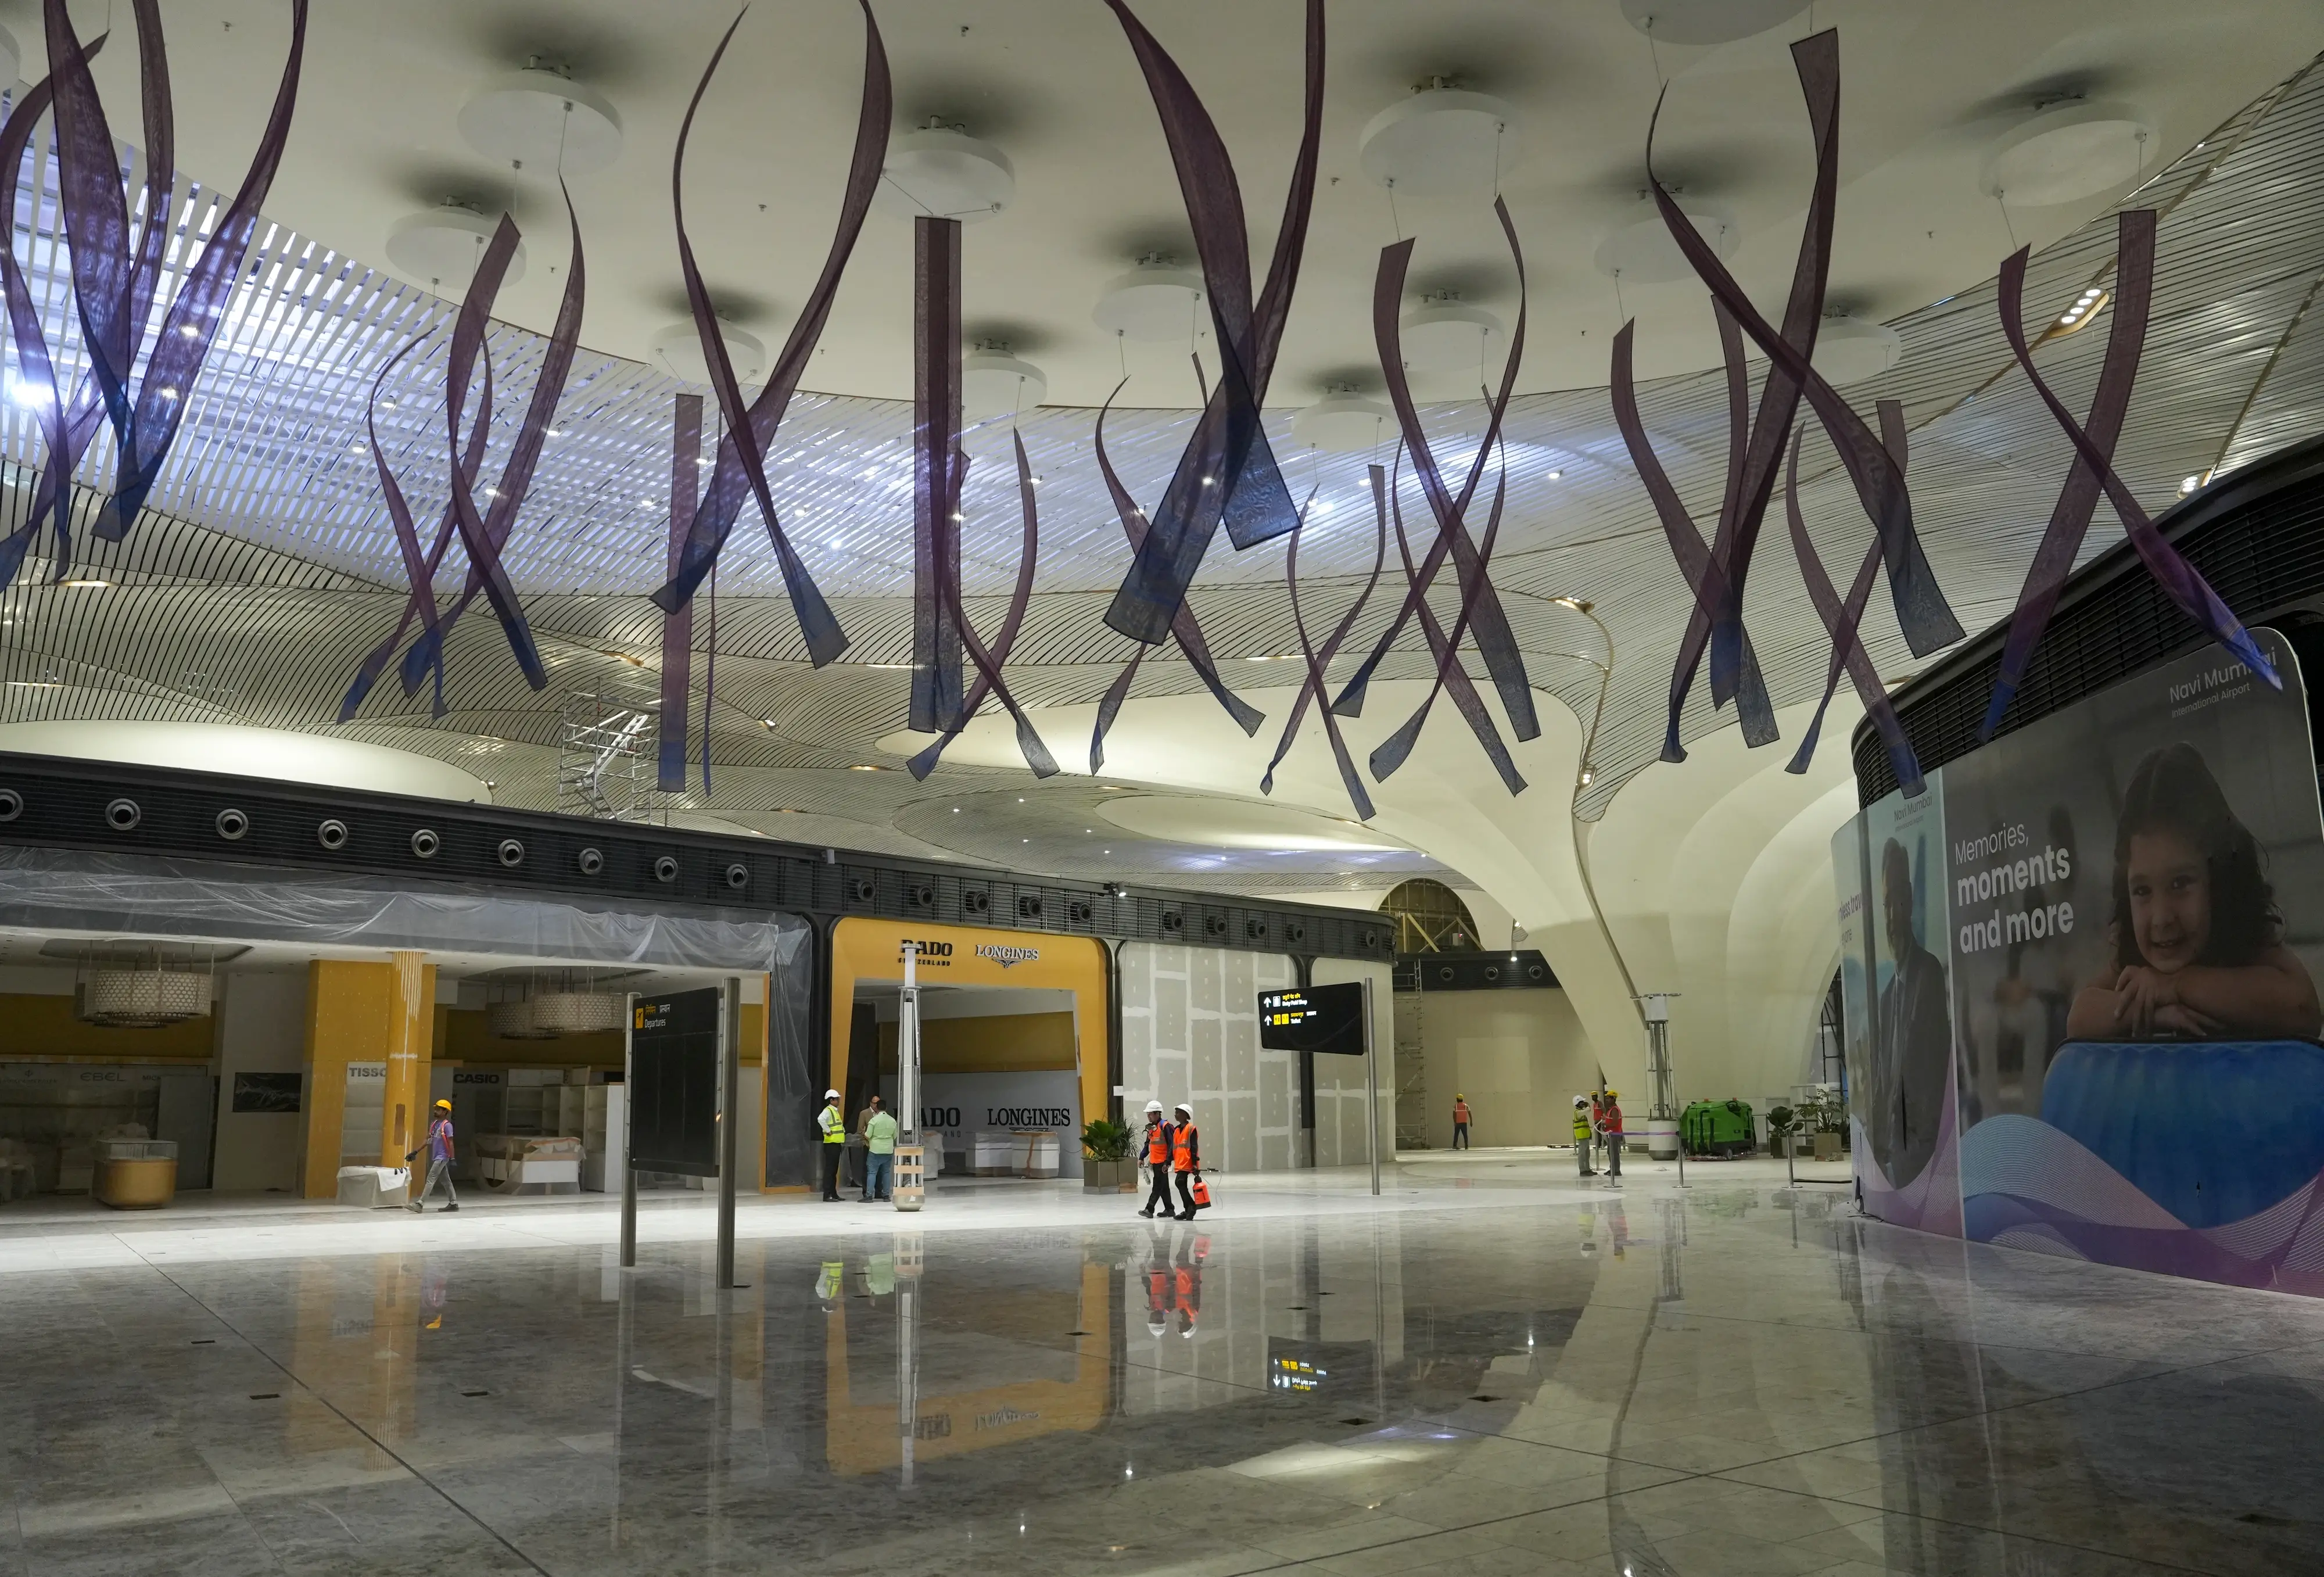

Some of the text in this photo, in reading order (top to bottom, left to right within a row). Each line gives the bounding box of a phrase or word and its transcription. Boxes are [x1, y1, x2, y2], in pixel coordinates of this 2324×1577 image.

[2169, 673, 2201, 703] Navi
[2172, 682, 2250, 718] International Airport
[1894, 792, 1932, 822] Navi Mumbai
[1955, 822, 2029, 865] Memories,
[1957, 845, 2070, 906] moments
[1960, 902, 2074, 954] and more
[975, 944, 1039, 960] LONGINES
[645, 1018, 666, 1030] Departures
[80, 1072, 125, 1082] EBEL
[454, 1074, 500, 1084] CASIO
[987, 1108, 1071, 1127] LONGINES
